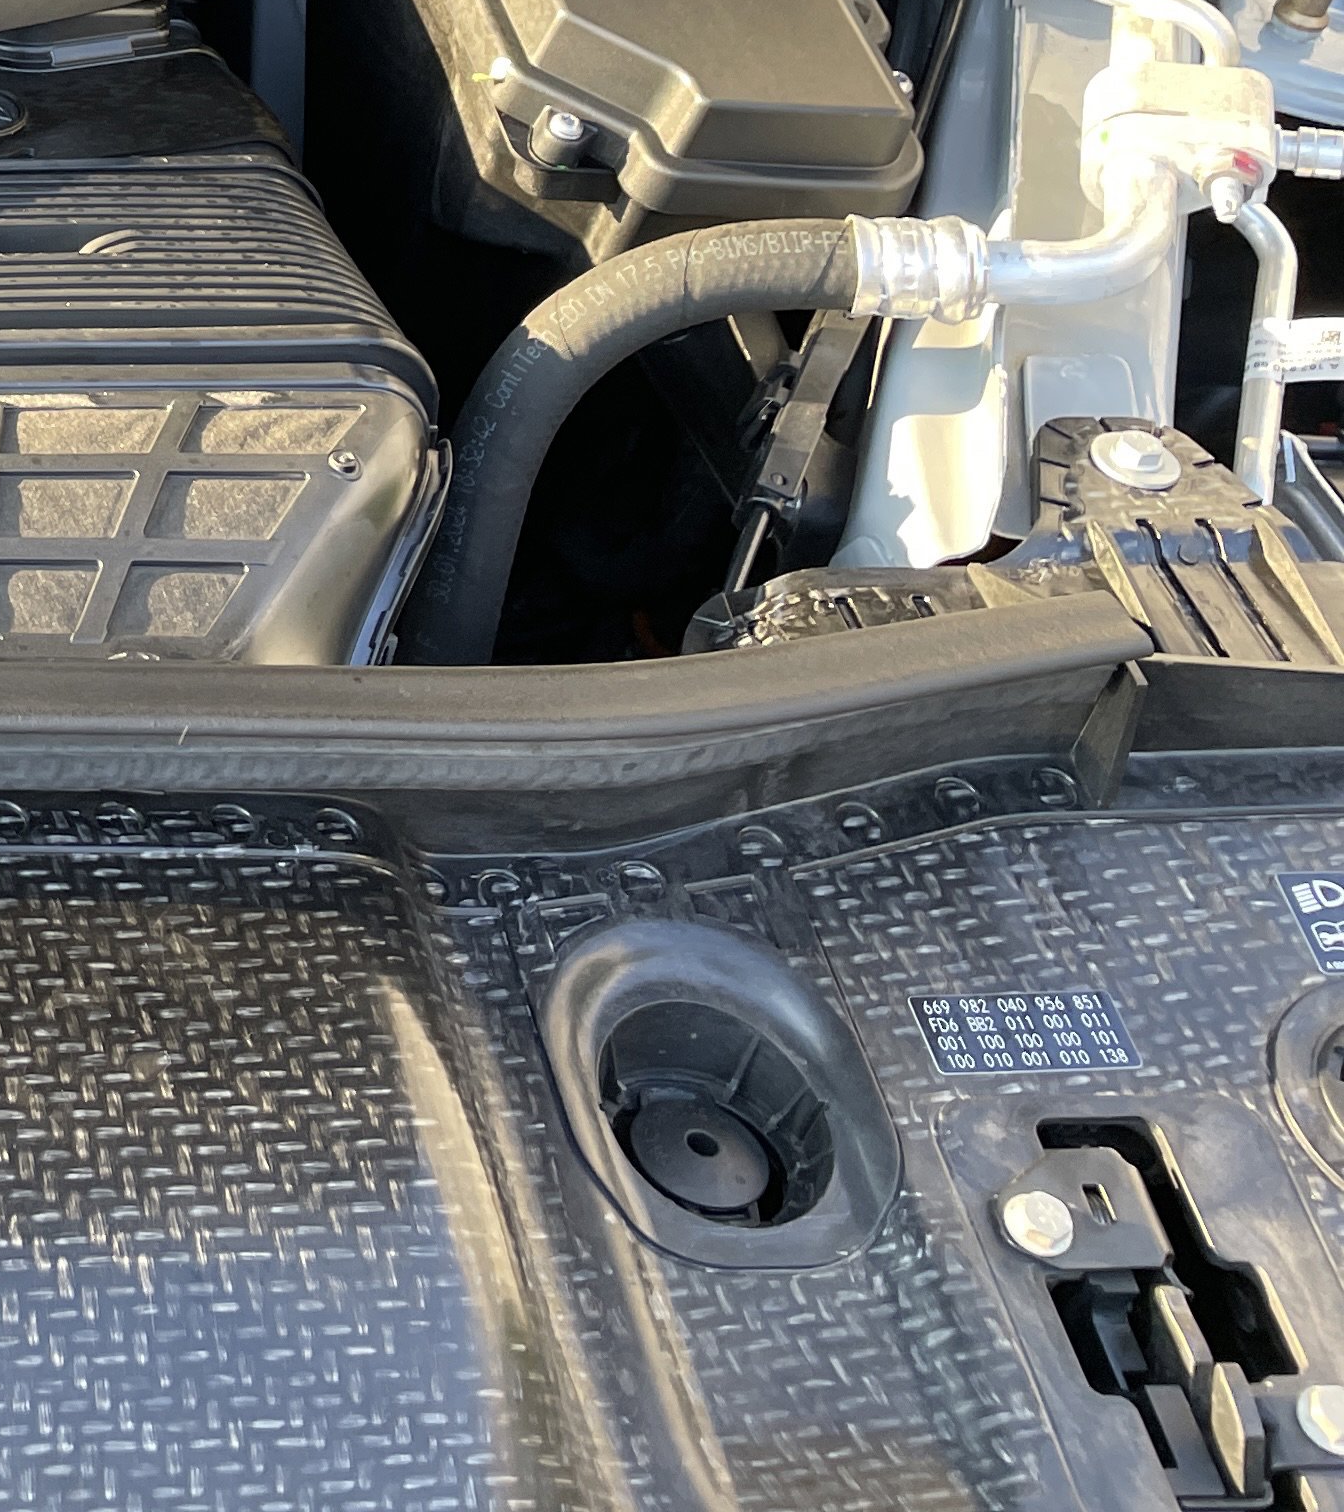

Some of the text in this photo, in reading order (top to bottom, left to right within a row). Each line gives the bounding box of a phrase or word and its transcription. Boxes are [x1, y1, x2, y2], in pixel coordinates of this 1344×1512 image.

[923, 995, 1102, 1015] 669 982 040 956 851
[928, 1012, 1110, 1032] FD6 BB2 011 001 011
[938, 1030, 1120, 1050] 001 100 100 100 101
[947, 1048, 1128, 1068] 100 010 001 010 138
